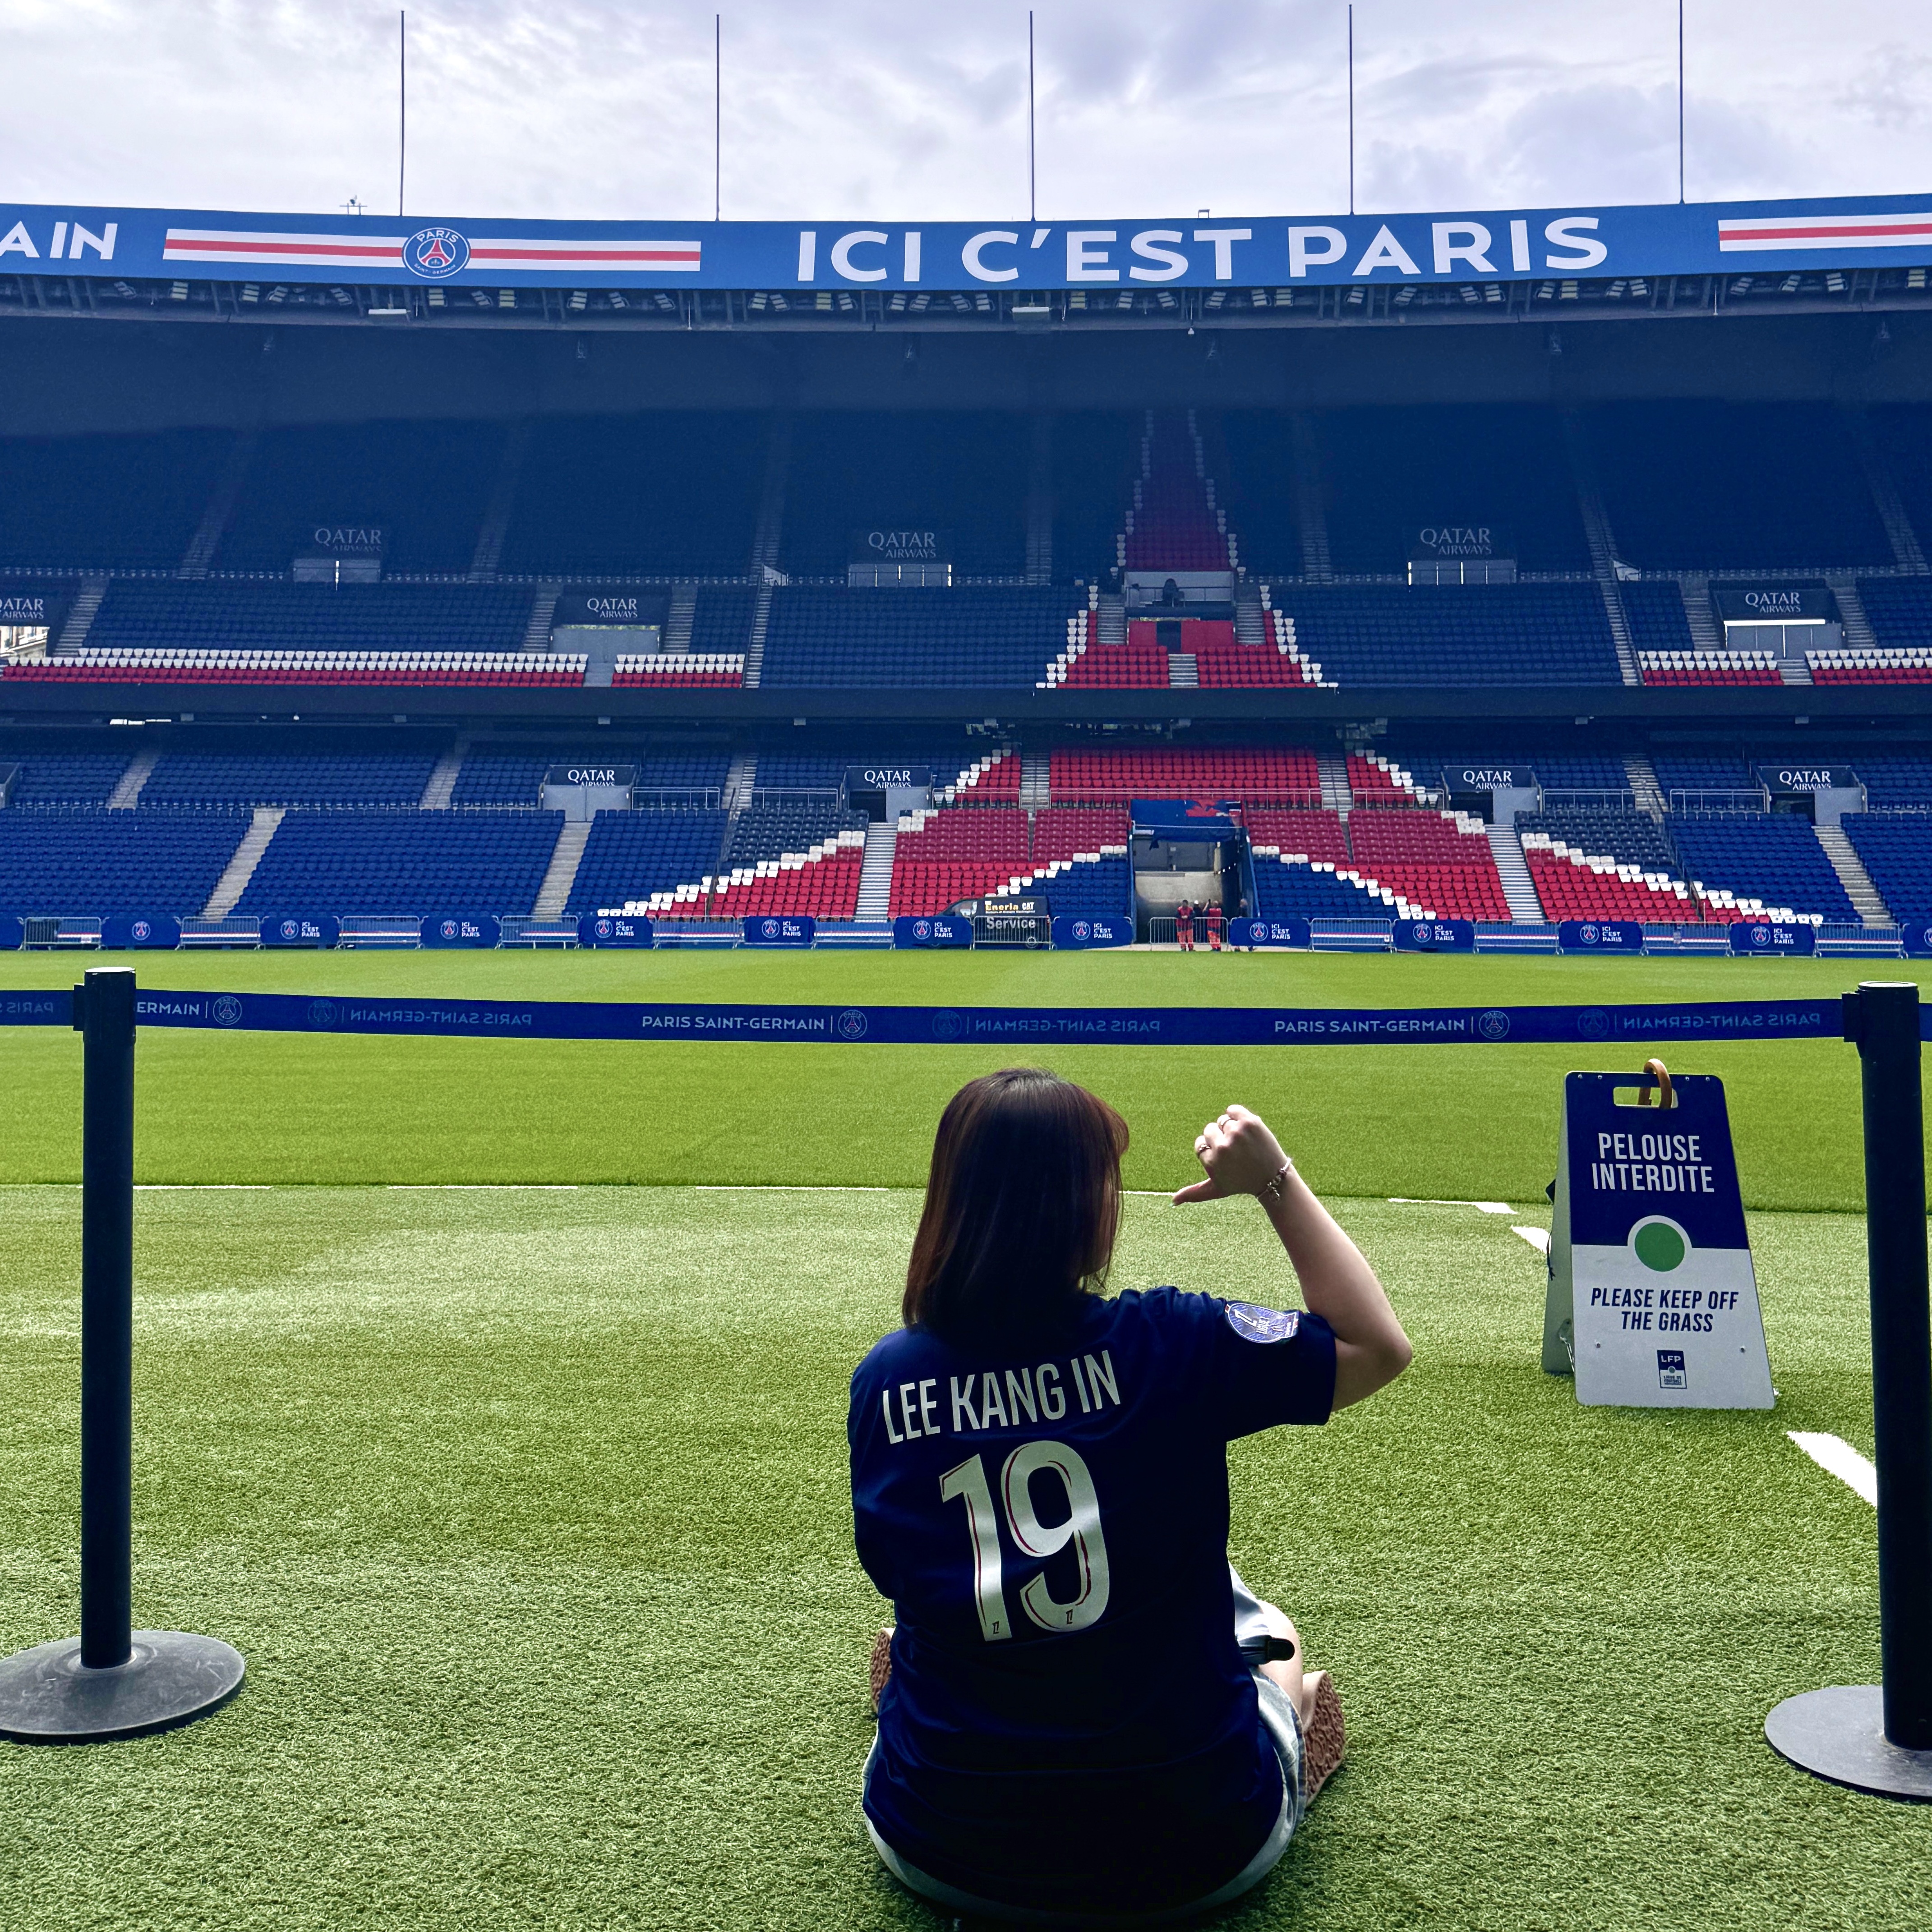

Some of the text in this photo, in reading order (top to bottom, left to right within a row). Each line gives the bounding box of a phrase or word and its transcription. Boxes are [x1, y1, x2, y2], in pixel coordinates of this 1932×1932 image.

[0, 221, 118, 260] AIN
[416, 230, 459, 243] PARIS
[798, 217, 1608, 281] ICI C'EST PARIS
[315, 528, 382, 546] QATAR
[868, 532, 936, 551] QATAR
[1420, 528, 1490, 547] QATAR
[885, 549, 936, 558] AIRWAYS
[1439, 545, 1491, 555] AIRWAYS
[587, 598, 637, 612] QATAR
[1745, 592, 1800, 607] QATAR
[3, 611, 44, 619] AIRWAYS
[1760, 605, 1801, 613] AIRWAYS
[568, 770, 615, 783] QATAR
[864, 770, 911, 784] QATAR
[1463, 771, 1512, 784] QATAR
[1780, 771, 1831, 785] QATAR
[987, 917, 1036, 929] Service
[642, 1016, 824, 1030] PARIS SAINT-GERMAIN
[1275, 1019, 1464, 1032] PARIS SAINT-GERMAIN
[1598, 1133, 1701, 1162] PELOUSE
[1592, 1163, 1715, 1192] INTERDITE
[1591, 1288, 1739, 1310] PLEASE KEEP OFF
[1621, 1311, 1713, 1332] THE GRASS
[883, 1350, 1121, 1444] LEE KANG IN
[939, 1440, 1110, 1641] 19
